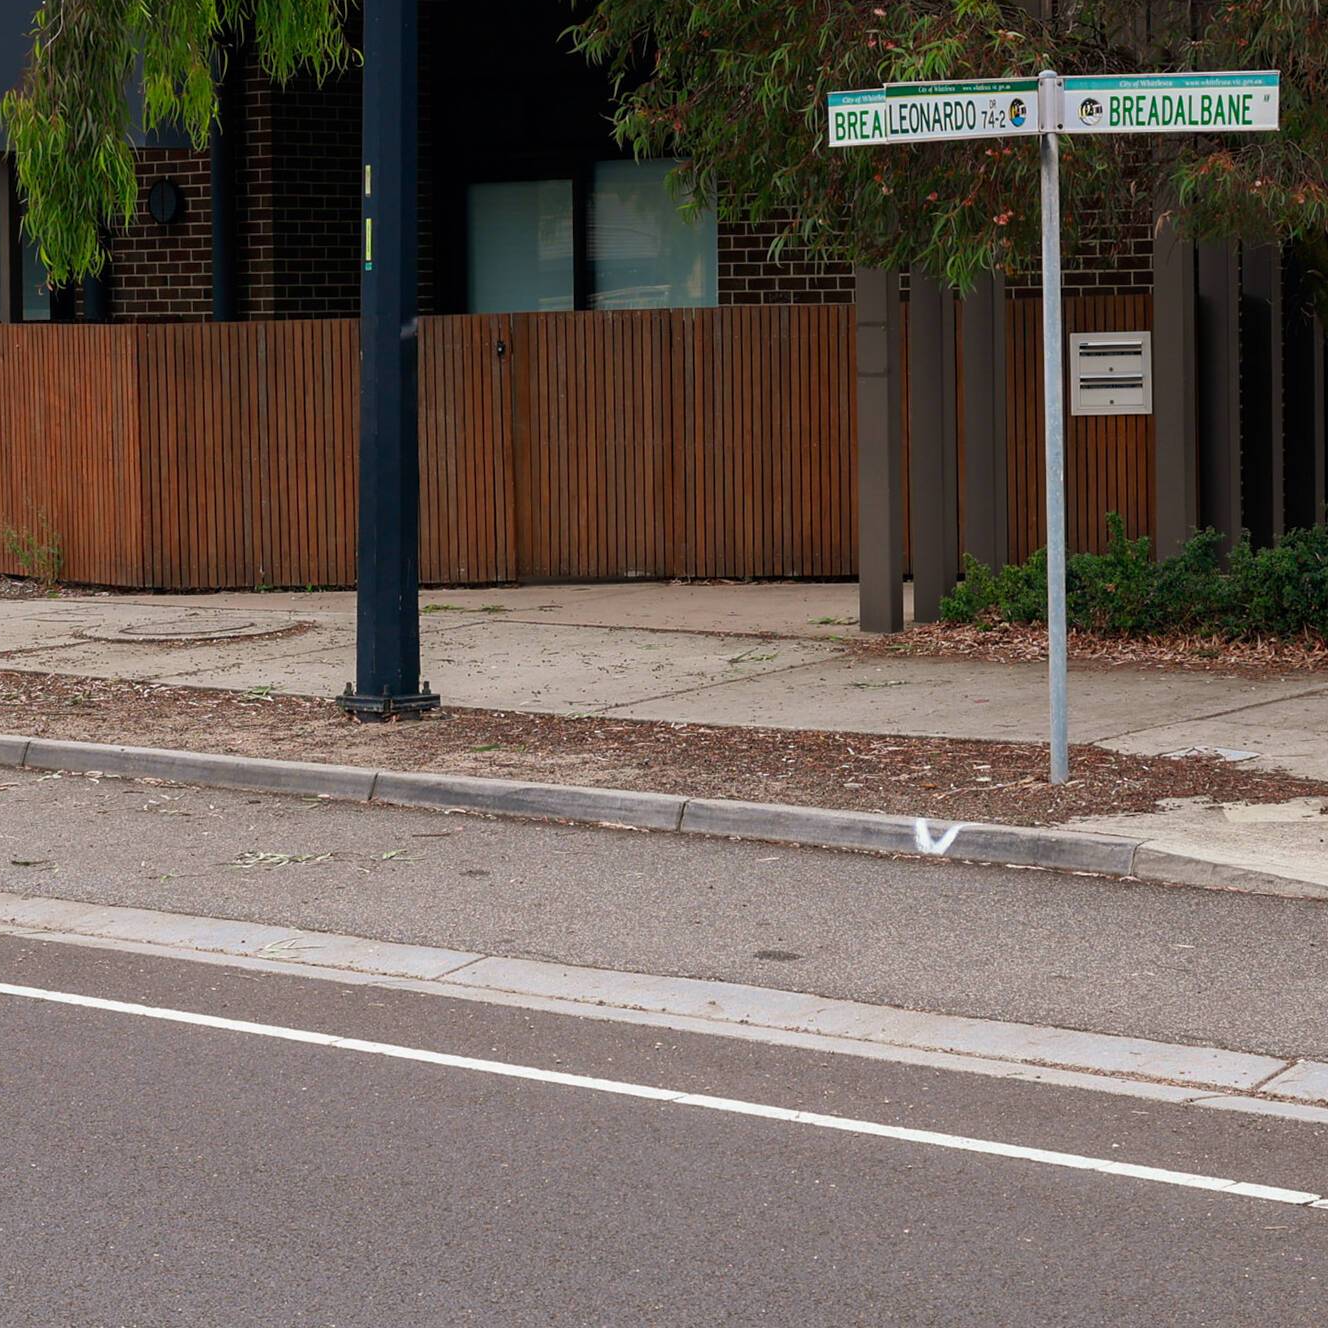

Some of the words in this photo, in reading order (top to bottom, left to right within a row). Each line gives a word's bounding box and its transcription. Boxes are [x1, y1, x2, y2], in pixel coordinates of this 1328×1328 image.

[889, 100, 976, 135] LEONARDO
[989, 99, 997, 109] DR
[1109, 94, 1253, 126] BREADALBANE
[835, 110, 886, 140] BREA
[981, 110, 1006, 129] 74-2
